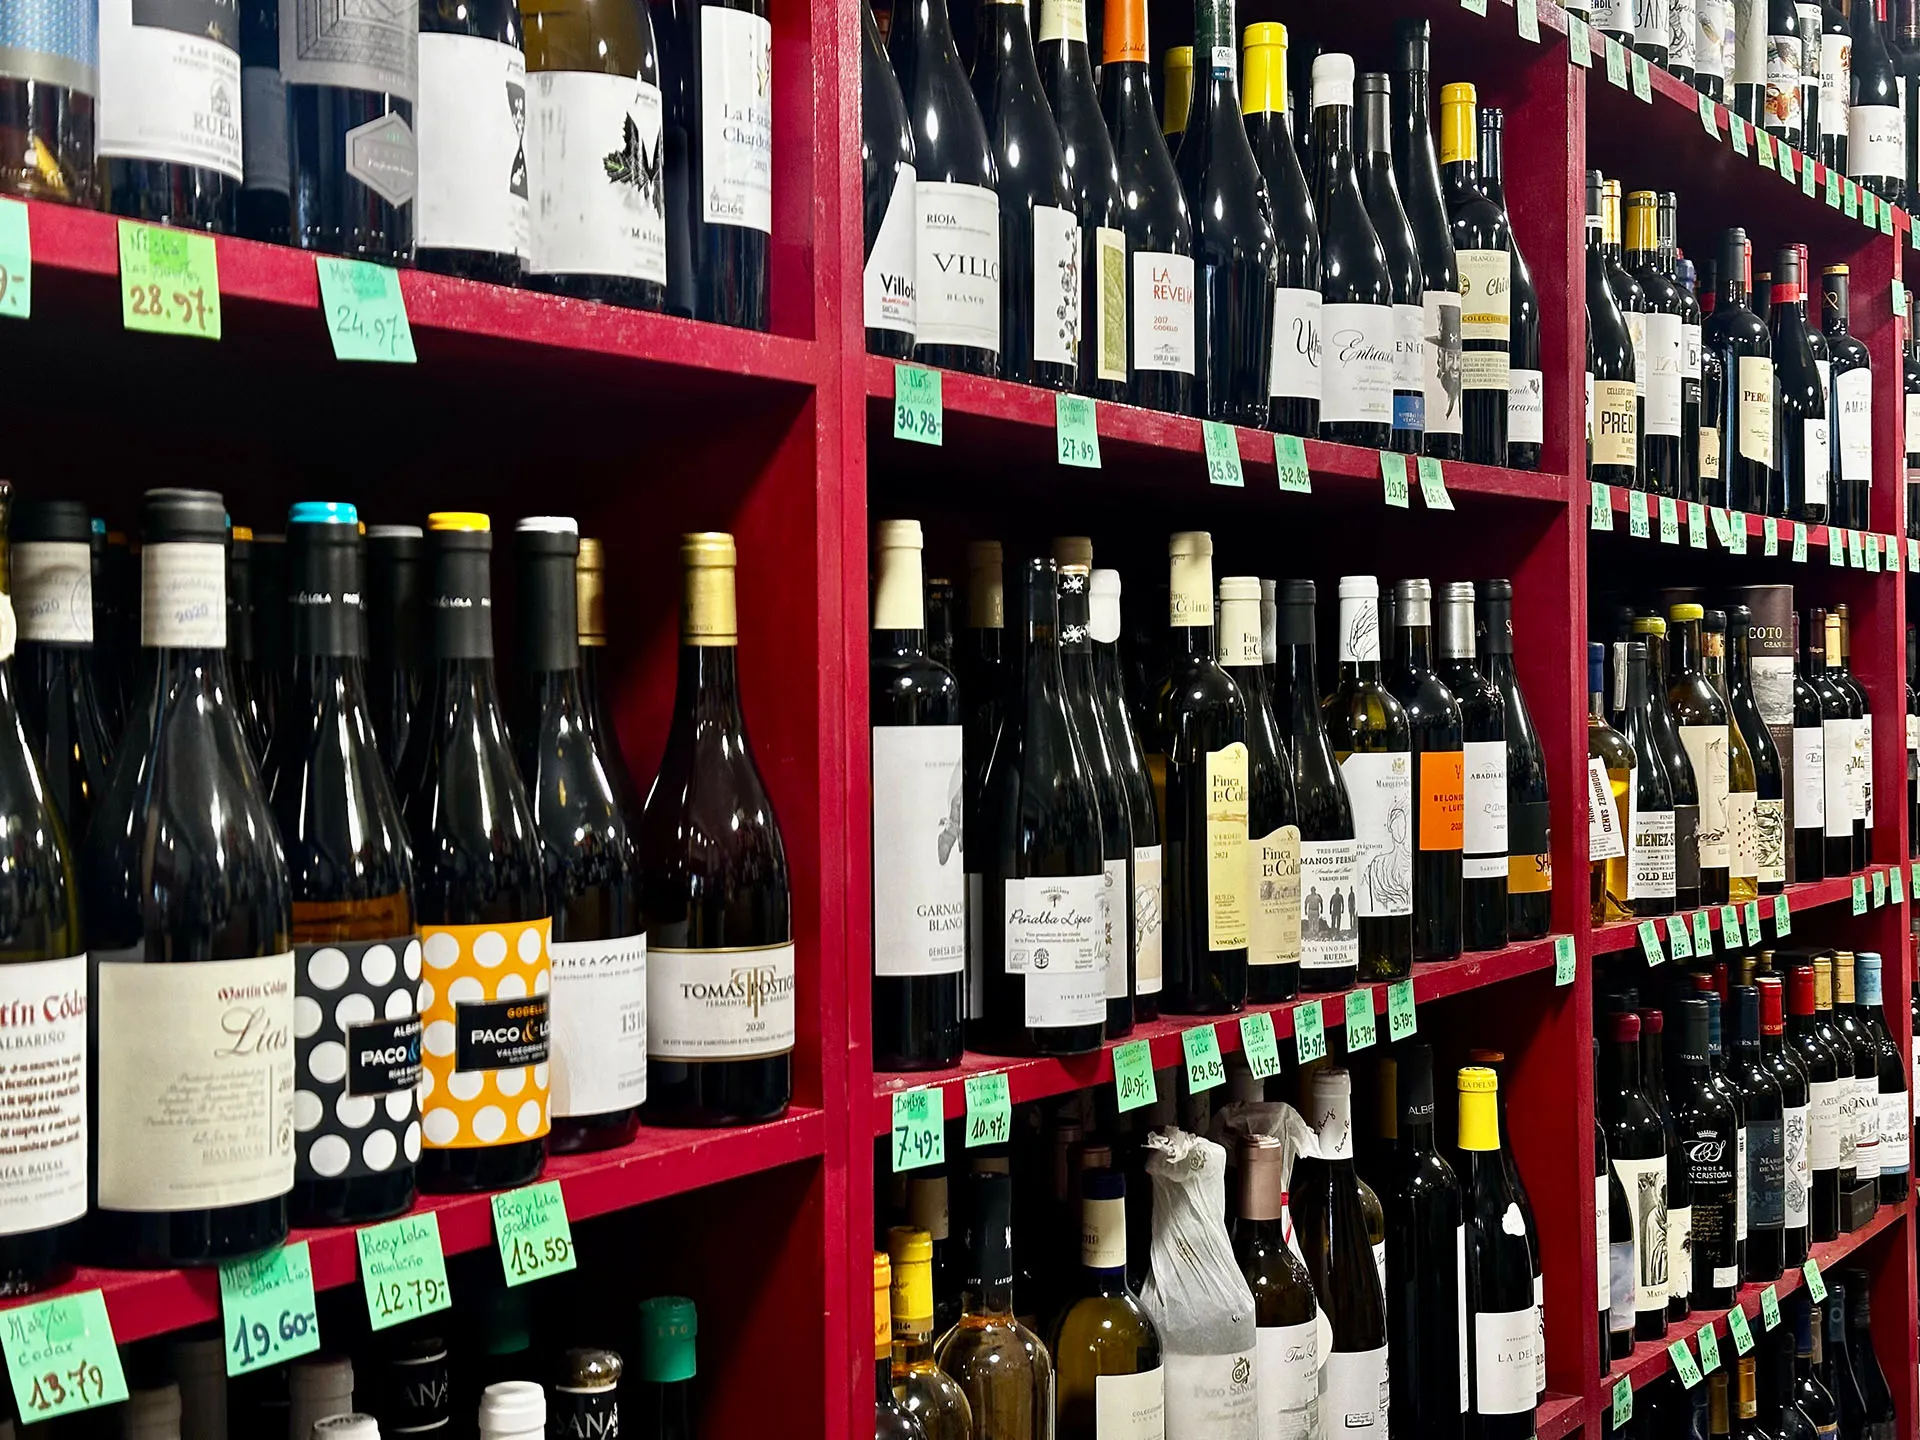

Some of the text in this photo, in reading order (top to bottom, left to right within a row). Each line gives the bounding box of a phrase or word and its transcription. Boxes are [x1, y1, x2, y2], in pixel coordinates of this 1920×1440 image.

[926, 214, 957, 225] RIOJA
[1152, 267, 1171, 283] LA
[946, 293, 984, 305] BLANCO
[1748, 626, 1783, 640] COTO
[1637, 872, 1660, 881] OLD
[1009, 908, 1059, 925] Peñalba
[551, 956, 596, 968] FINCA
[1323, 952, 1348, 961] RUEDA
[680, 979, 746, 1000] TOMÁS
[745, 1021, 766, 1033] 2020
[471, 1026, 520, 1046] PACO
[361, 1045, 406, 1068] PACO
[1695, 1171, 1733, 1180] CRISTOBAL
[1497, 1352, 1513, 1363] LA
[28, 1359, 104, 1411] 13.79
